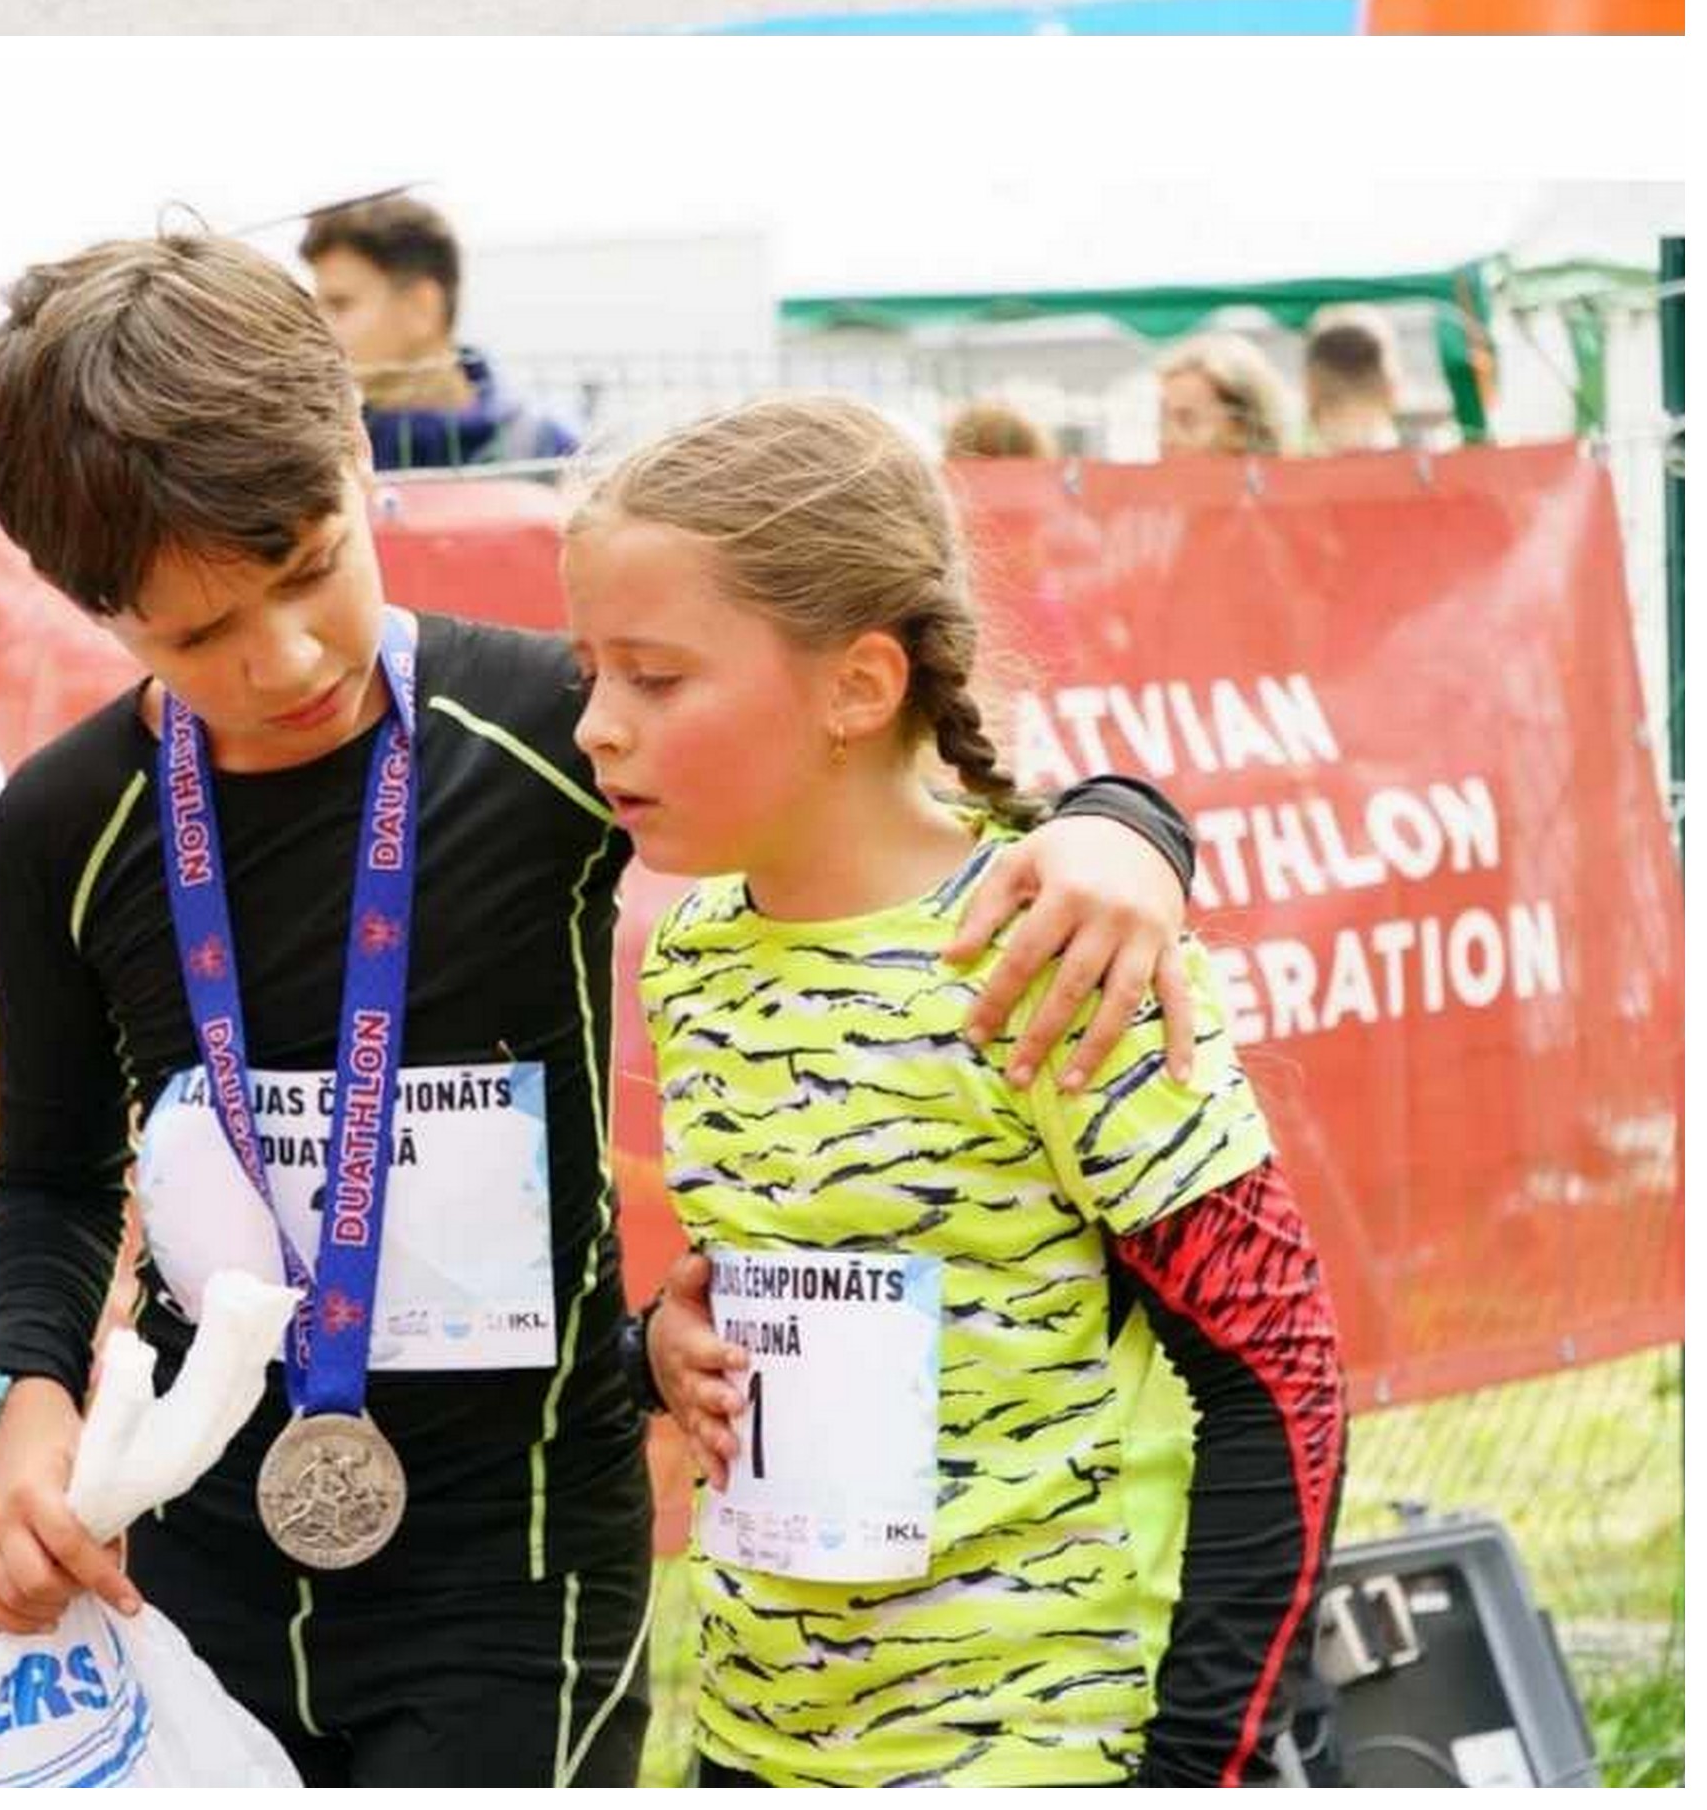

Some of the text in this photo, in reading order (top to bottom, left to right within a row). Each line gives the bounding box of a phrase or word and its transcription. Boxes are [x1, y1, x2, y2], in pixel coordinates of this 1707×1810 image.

[1012, 673, 1340, 791] ATVIAN
[1190, 776, 1501, 909] THLON
[1219, 900, 1562, 1045] ERATION
[178, 1073, 512, 1116] LAJAS ČIONĀTS
[262, 1128, 417, 1167] DUATĀ
[330, 1009, 391, 1248] DUATHLON
[744, 1256, 905, 1302] ČEMPIONĀTS
[748, 1371, 764, 1478] 1
